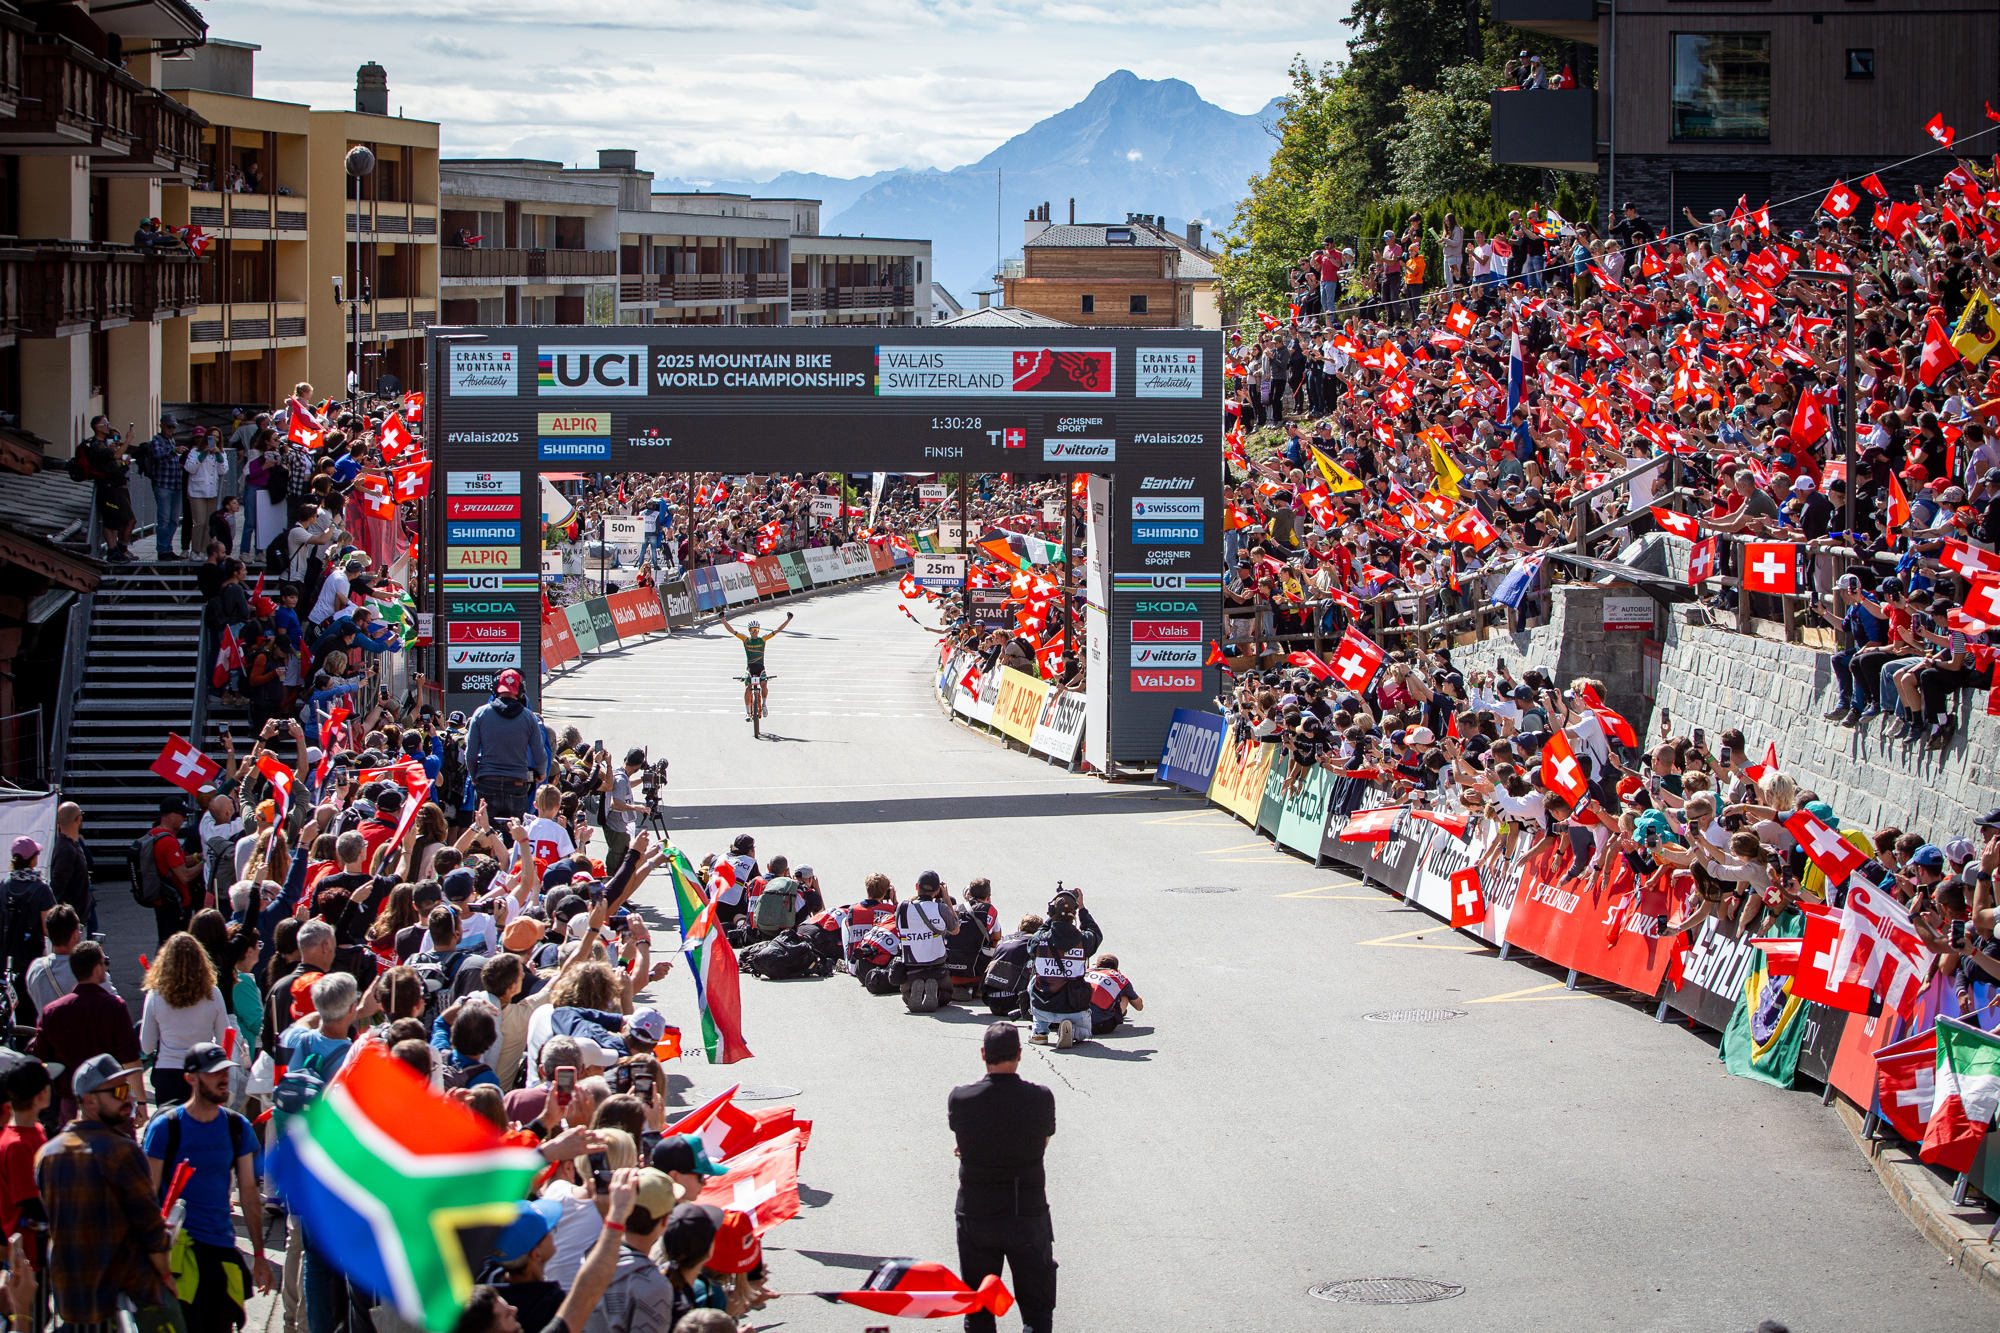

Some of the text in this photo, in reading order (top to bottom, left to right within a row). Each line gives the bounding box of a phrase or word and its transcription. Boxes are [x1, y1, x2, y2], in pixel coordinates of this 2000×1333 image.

[456, 352, 493, 361] CRANS
[656, 354, 832, 368] 2025 MOUNTAIN BIKE
[888, 353, 944, 368] VALAIS
[1142, 354, 1178, 363] CRANS
[456, 362, 512, 372] MONTANA
[556, 354, 638, 387] UCI
[1142, 364, 1196, 374] MONTANA
[458, 373, 508, 388] Absolutely
[656, 372, 866, 388] WORLD CHAMPIONSHIPS
[888, 373, 1004, 388] SWITZERLAND
[1144, 377, 1192, 391] Absolutely
[552, 417, 597, 433] ALPIQ
[931, 417, 982, 430] 1:30:28
[1057, 424, 1087, 432] SPORT
[448, 431, 519, 444] #Valais2025
[628, 438, 672, 446] TISSOT
[1134, 433, 1204, 445] #Valais2025
[544, 444, 605, 454] SHIMANO
[924, 446, 964, 458] FINISH
[1065, 444, 1109, 456] vittoria
[1140, 476, 1196, 490] Santini
[1148, 502, 1200, 513] swisscom
[452, 528, 515, 538] SHIMANO
[612, 524, 635, 532] 50m
[1137, 528, 1198, 538] SHIMANO
[460, 550, 508, 566] ALPIQ
[927, 564, 954, 574] 25m
[469, 576, 498, 588] UCI
[1152, 576, 1182, 588] UCI
[975, 608, 1008, 618] START
[476, 627, 507, 637] Valais
[1158, 626, 1188, 636] Valais
[469, 651, 516, 663] vittoria
[1152, 650, 1196, 662] vittoria
[1138, 675, 1196, 687] ValJob
[1162, 722, 1220, 777] SHIMANO
[907, 932, 932, 941] STAFF
